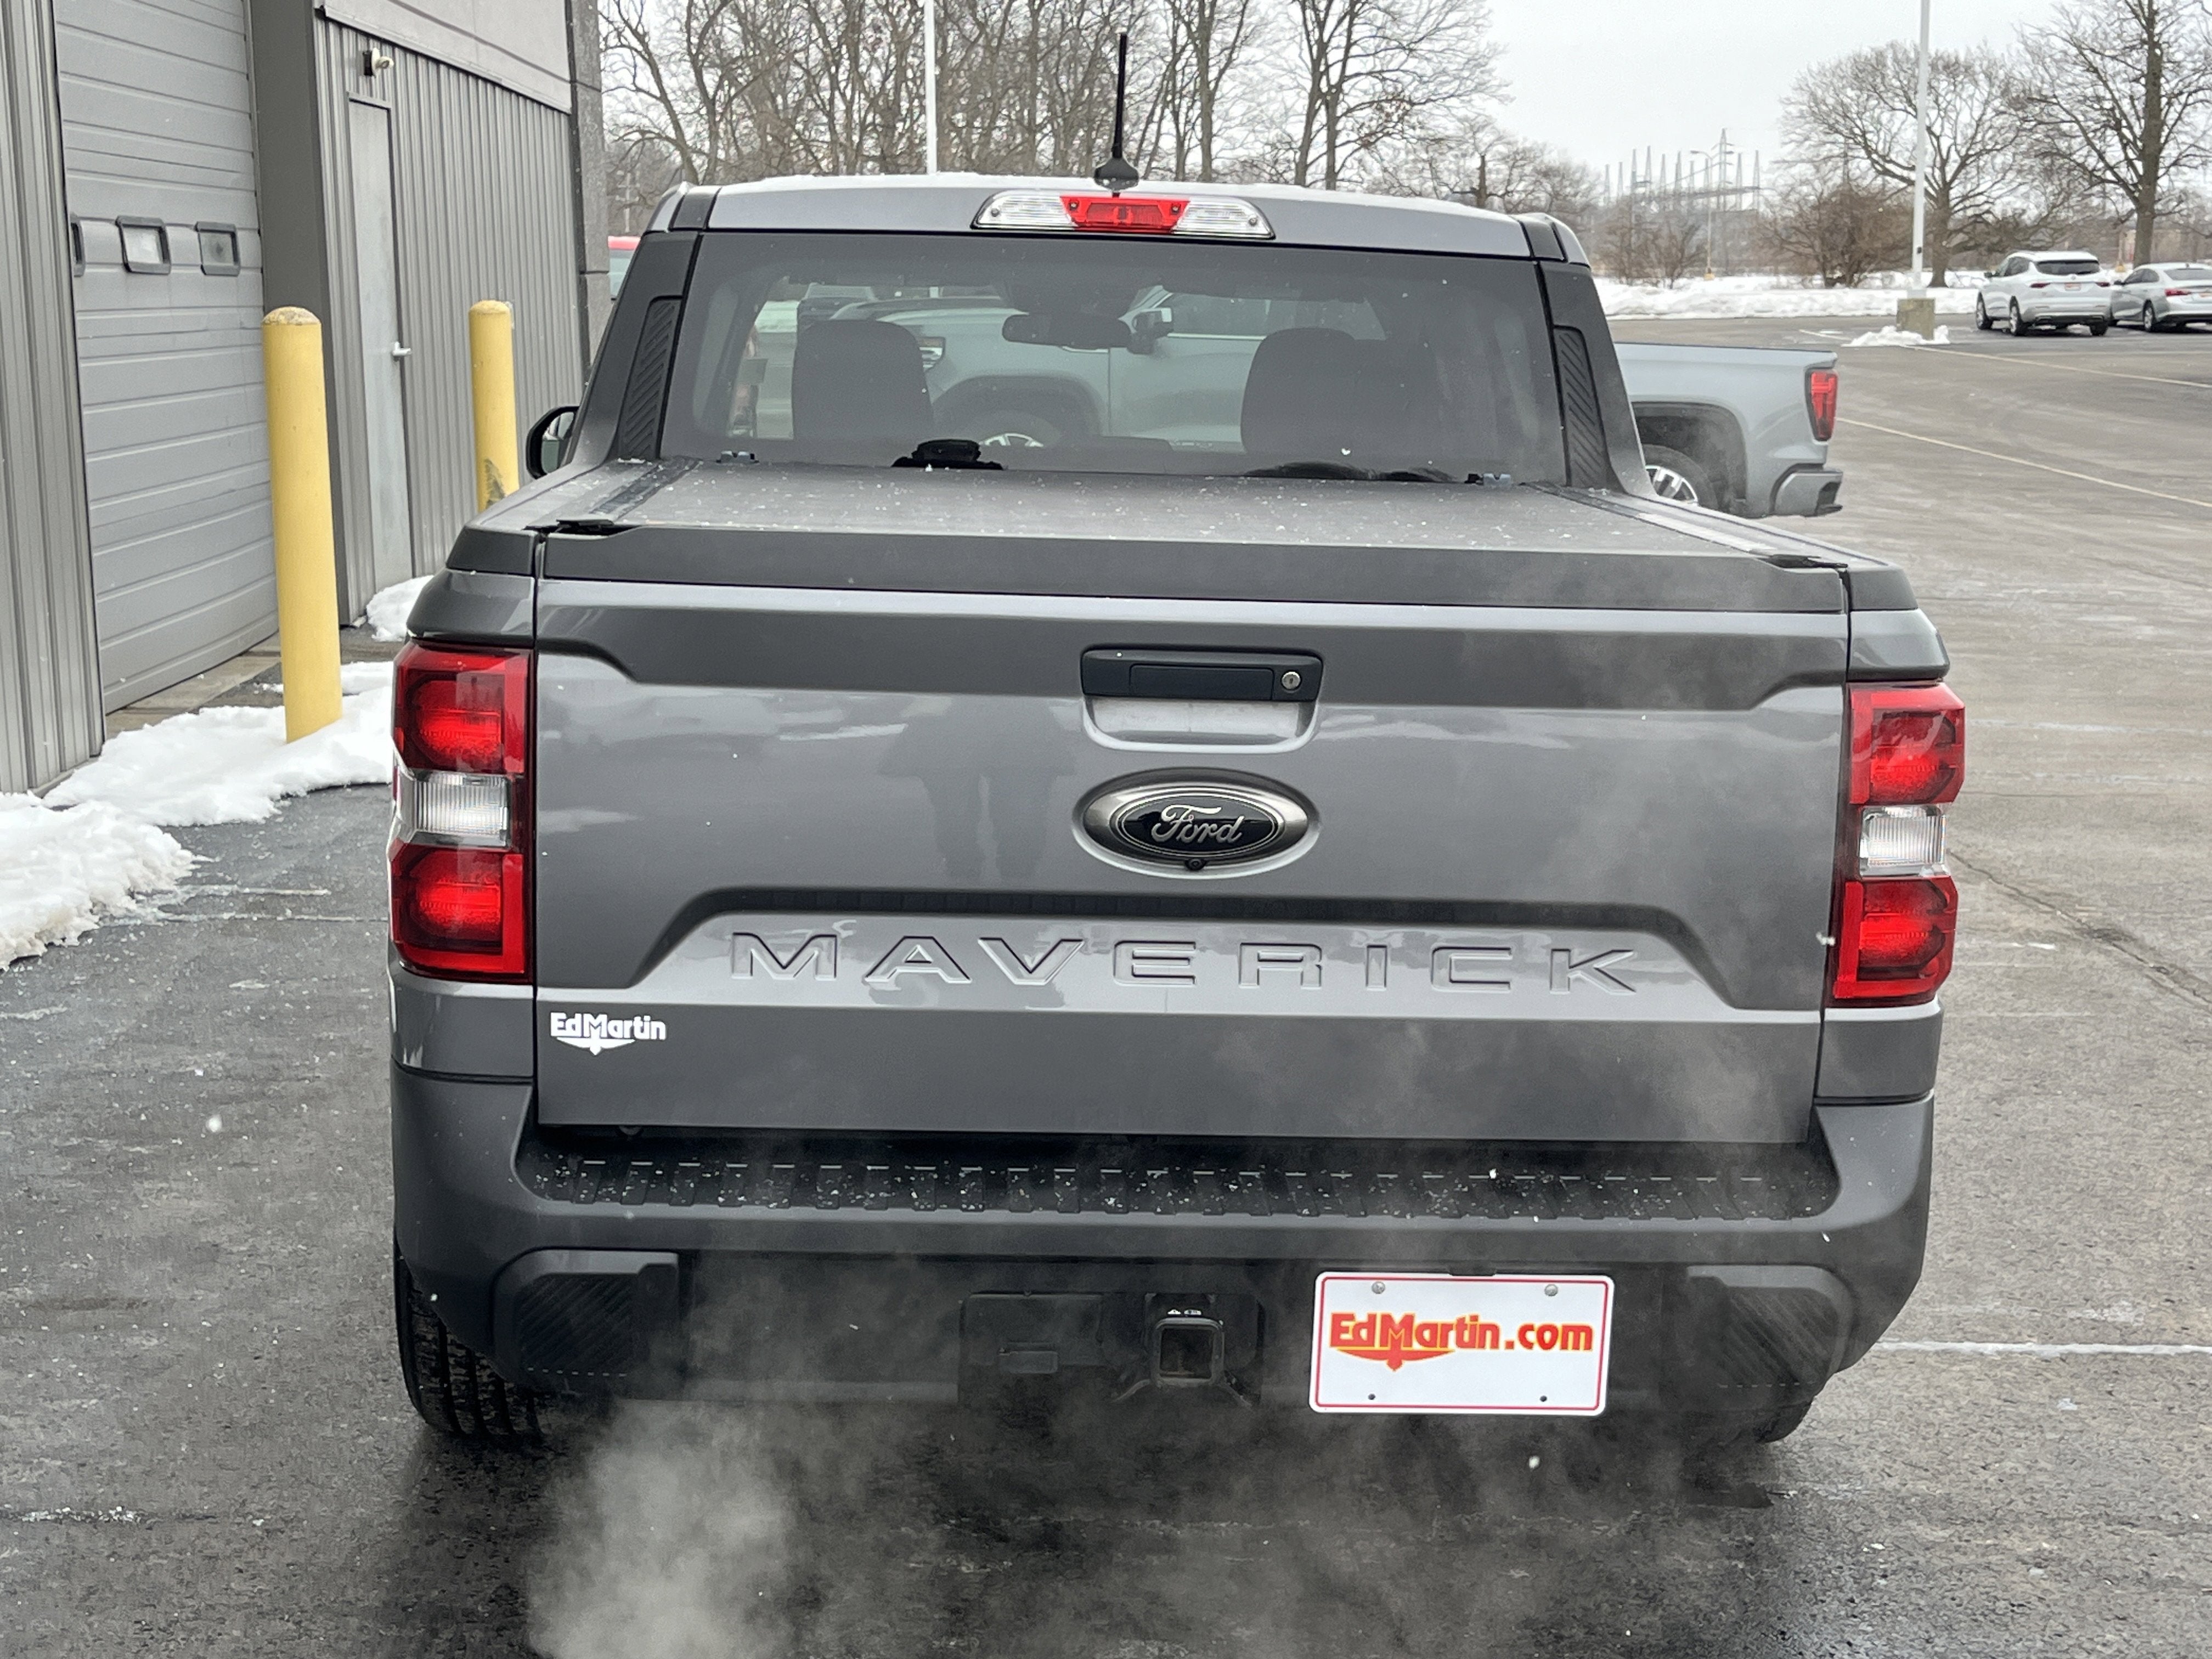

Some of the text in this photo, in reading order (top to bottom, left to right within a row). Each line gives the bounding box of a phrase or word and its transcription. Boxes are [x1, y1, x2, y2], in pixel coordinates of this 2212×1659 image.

[1151, 804, 1244, 844] Ford
[731, 932, 1637, 994] MAVERICK
[1329, 1312, 1595, 1351] EdMartin.com
